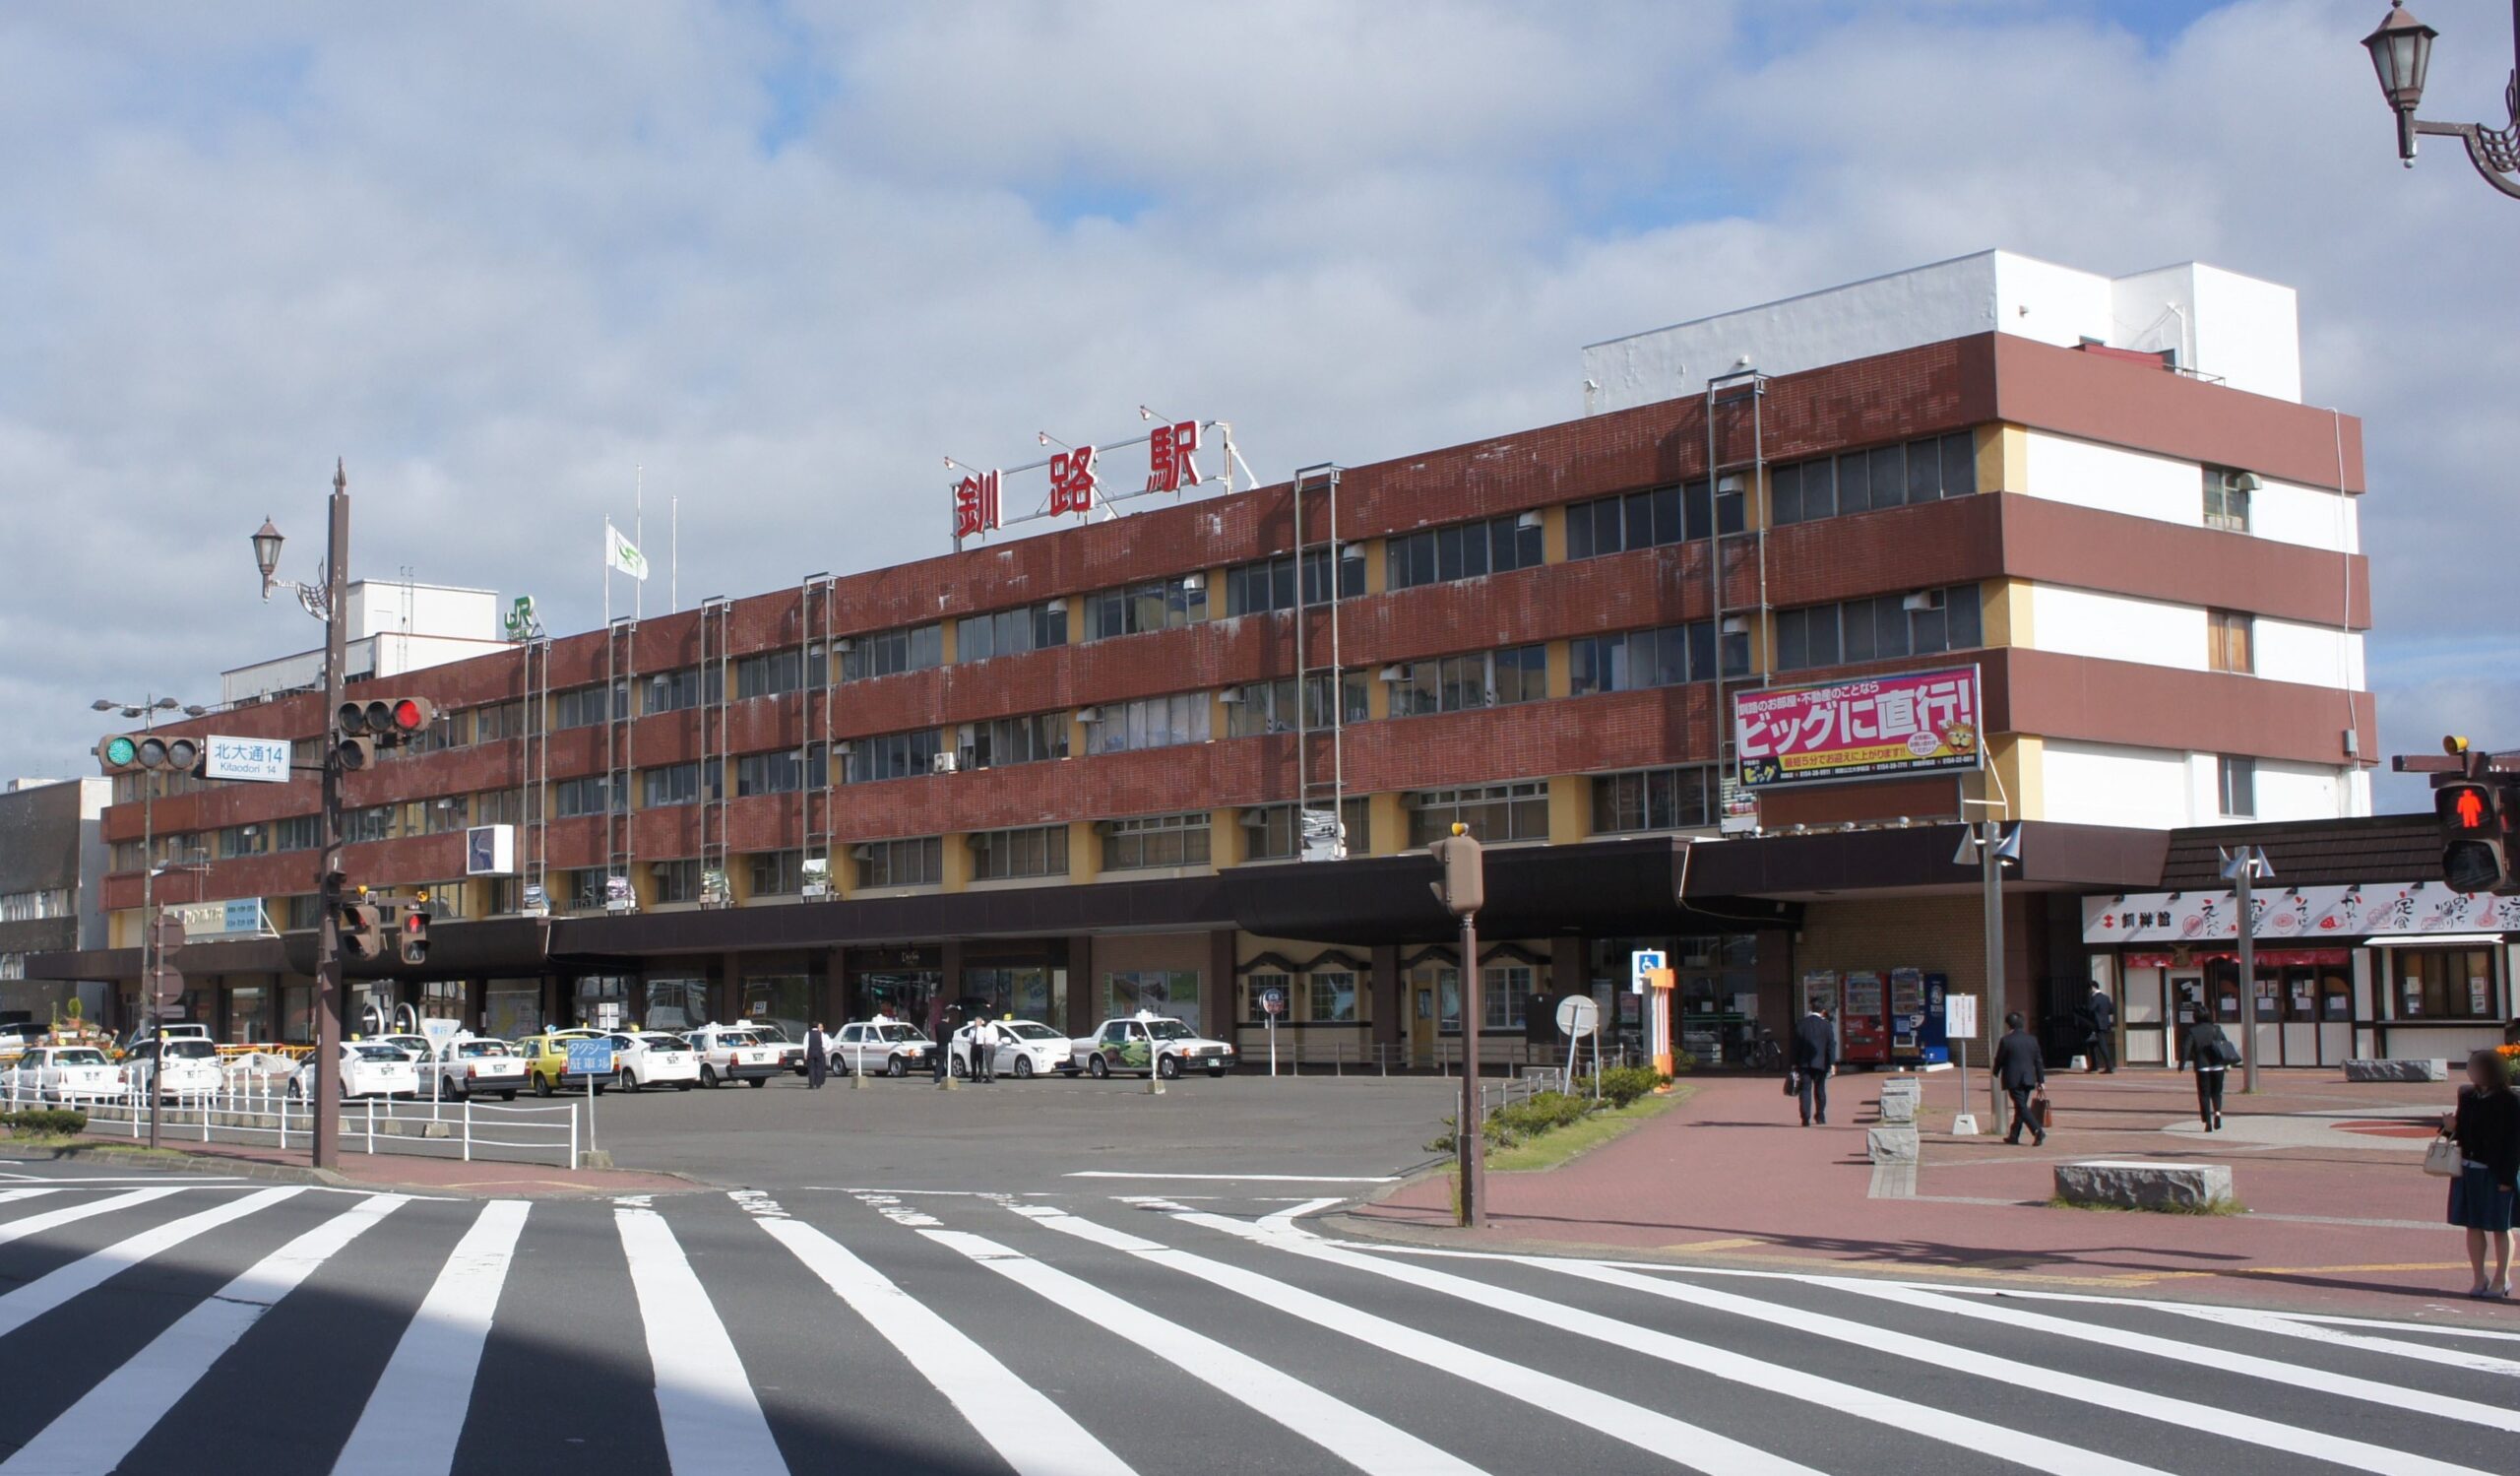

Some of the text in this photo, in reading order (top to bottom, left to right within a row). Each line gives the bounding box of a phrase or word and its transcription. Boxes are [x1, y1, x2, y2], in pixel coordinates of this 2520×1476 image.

[957, 419, 1202, 538] 釧路駅
[504, 596, 534, 630] JR
[215, 742, 284, 763] 北大通14
[220, 762, 277, 774] Kitaodori 14
[2394, 891, 2414, 929] 定食
[569, 1043, 609, 1056] タクシー
